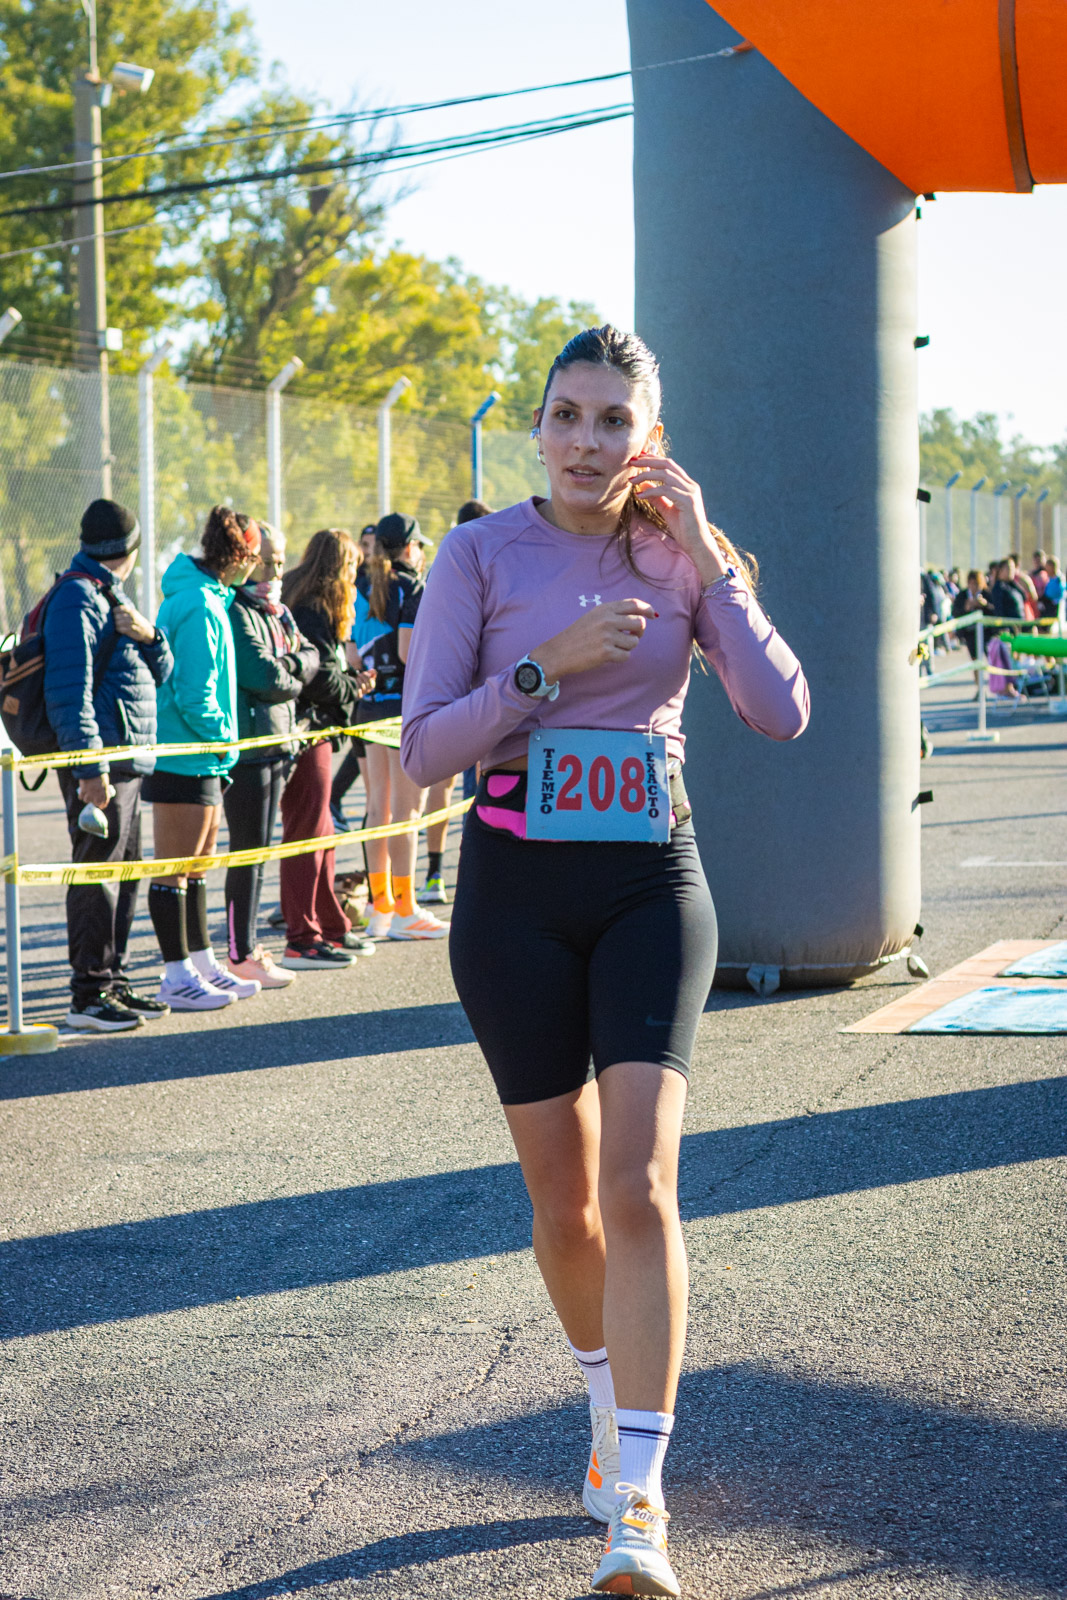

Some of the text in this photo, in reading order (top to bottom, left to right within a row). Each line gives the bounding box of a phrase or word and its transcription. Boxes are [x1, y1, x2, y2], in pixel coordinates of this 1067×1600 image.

[540, 748, 555, 814] TIEMPO
[556, 754, 646, 813] 208
[645, 752, 659, 818] EXACTO
